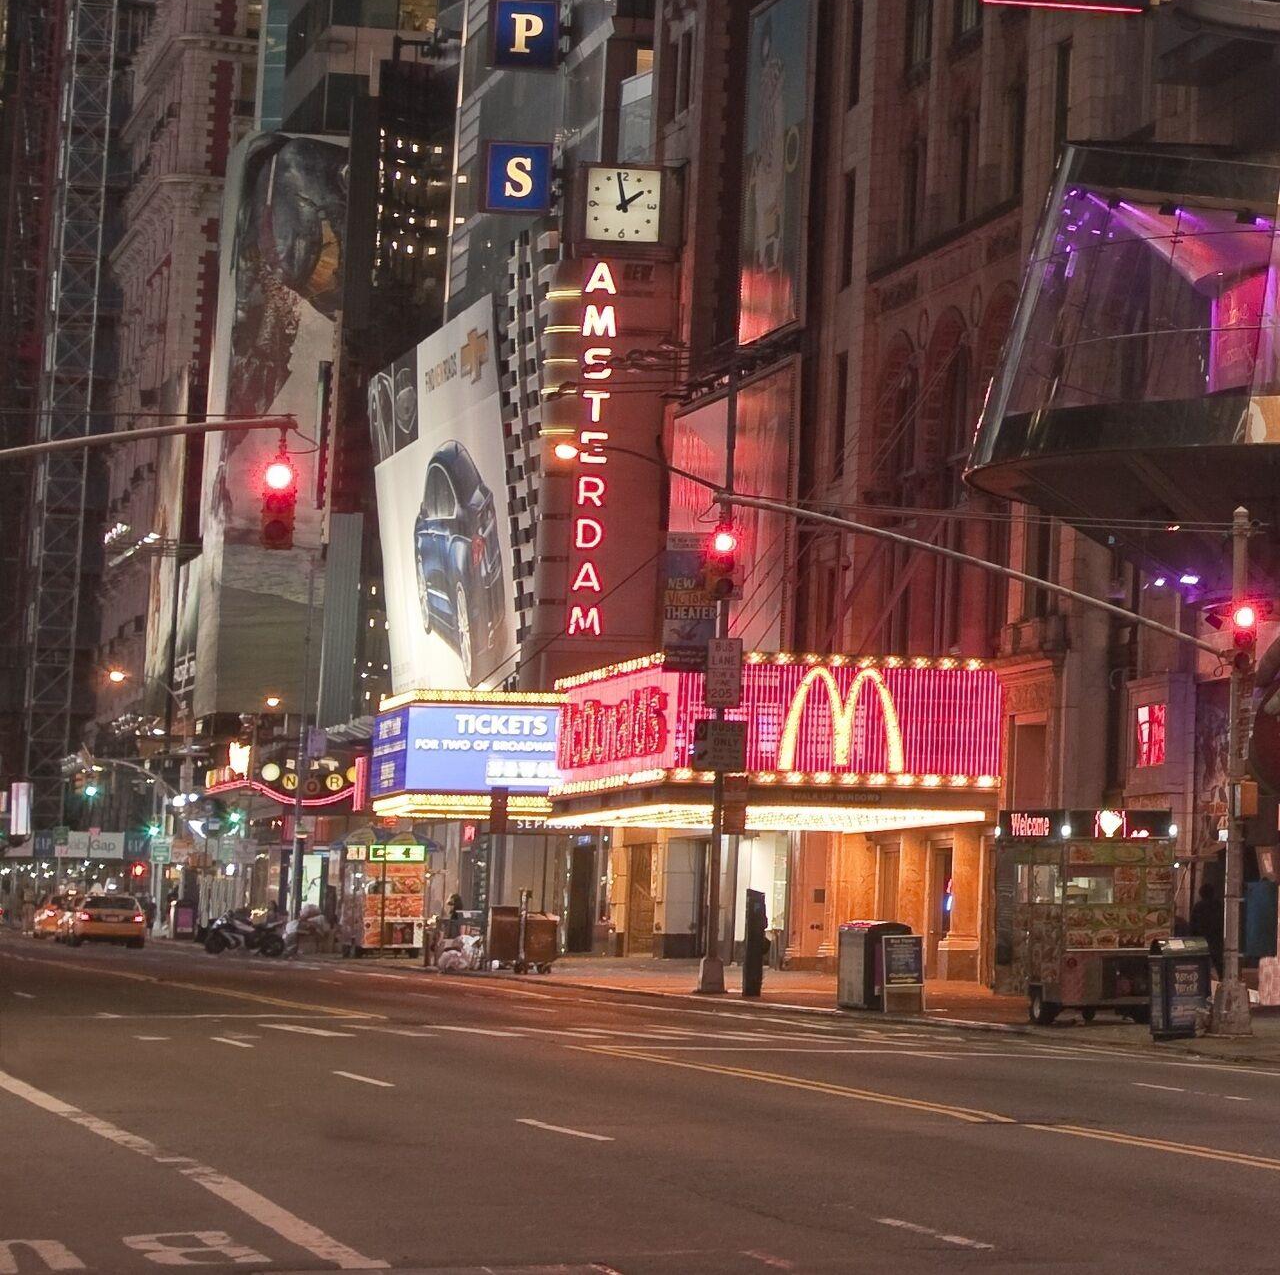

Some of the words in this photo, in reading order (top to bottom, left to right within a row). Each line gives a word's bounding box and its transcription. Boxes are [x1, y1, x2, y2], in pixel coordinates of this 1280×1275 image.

[568, 262, 617, 636] AMSTERDAM
[667, 577, 696, 591] NEW
[665, 606, 717, 620] THEATER
[455, 714, 548, 736] TICKETS
[442, 739, 470, 751] TWO
[473, 740, 490, 751] OF
[1011, 813, 1050, 837] Welcome
